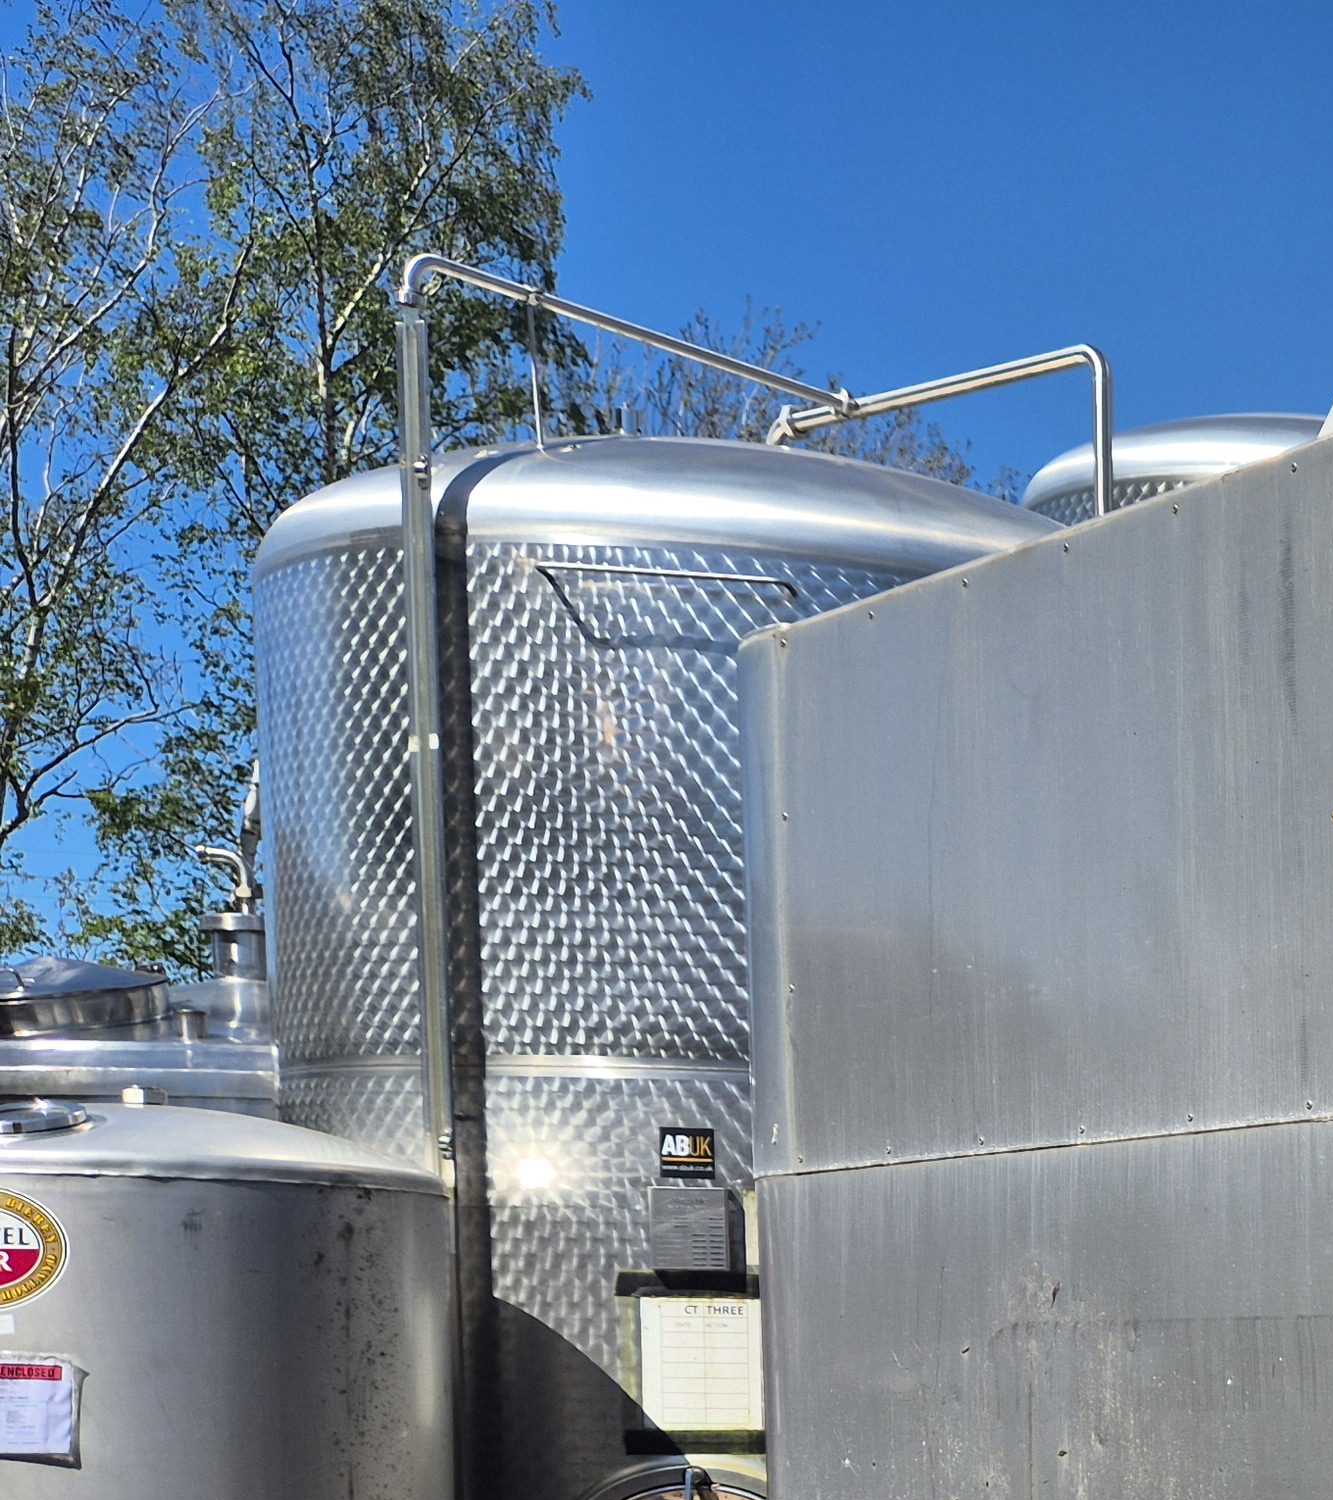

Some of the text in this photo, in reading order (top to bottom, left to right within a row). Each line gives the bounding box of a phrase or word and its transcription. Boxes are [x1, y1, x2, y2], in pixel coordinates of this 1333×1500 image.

[661, 1134, 712, 1156] ABUK
[0, 1227, 30, 1245] EL
[1, 1254, 57, 1300] HOLLAND
[684, 1305, 744, 1315] CT THREE
[0, 1366, 55, 1378] ENCLOSED
